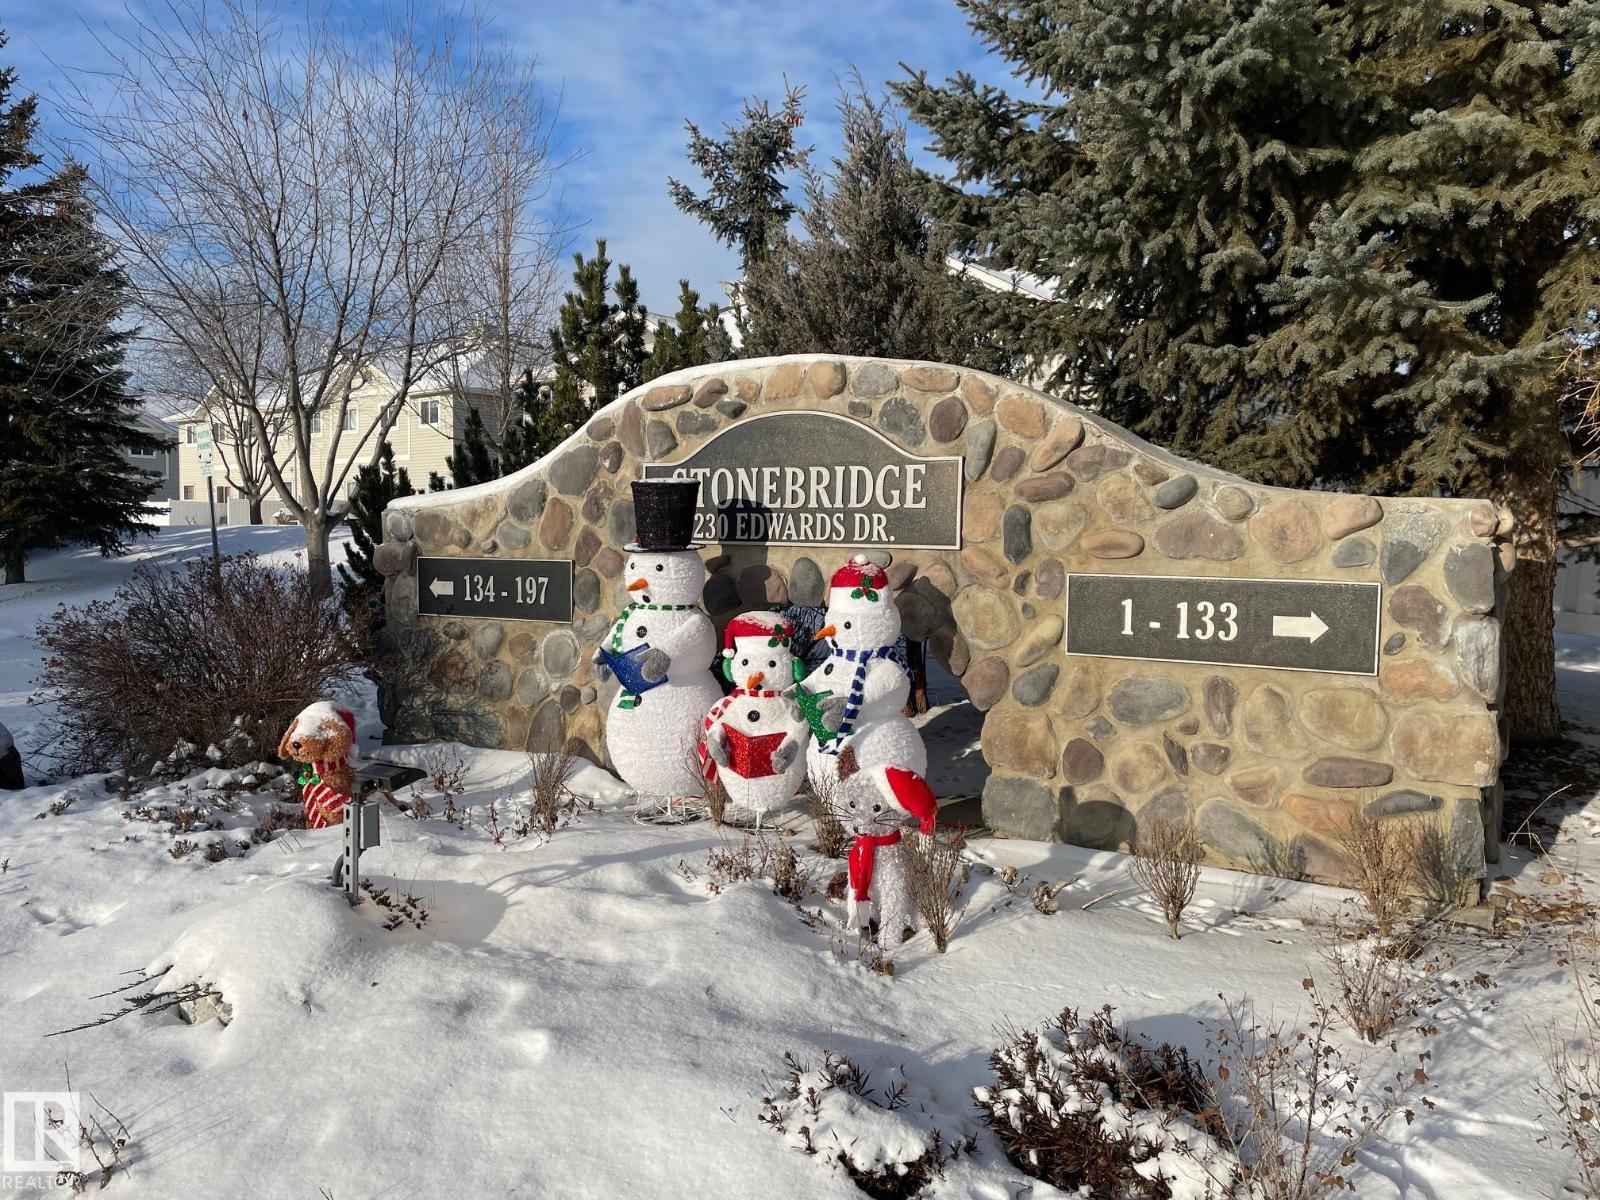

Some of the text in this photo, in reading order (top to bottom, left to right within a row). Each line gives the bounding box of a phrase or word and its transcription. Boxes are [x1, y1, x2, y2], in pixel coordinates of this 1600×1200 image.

[672, 463, 927, 509] TONEBRIDGE
[693, 512, 896, 542] 230 EDWARDS DR.
[463, 574, 496, 602] 134
[515, 576, 549, 605] 197
[1120, 598, 1134, 635] 1
[1176, 601, 1239, 641] 133
